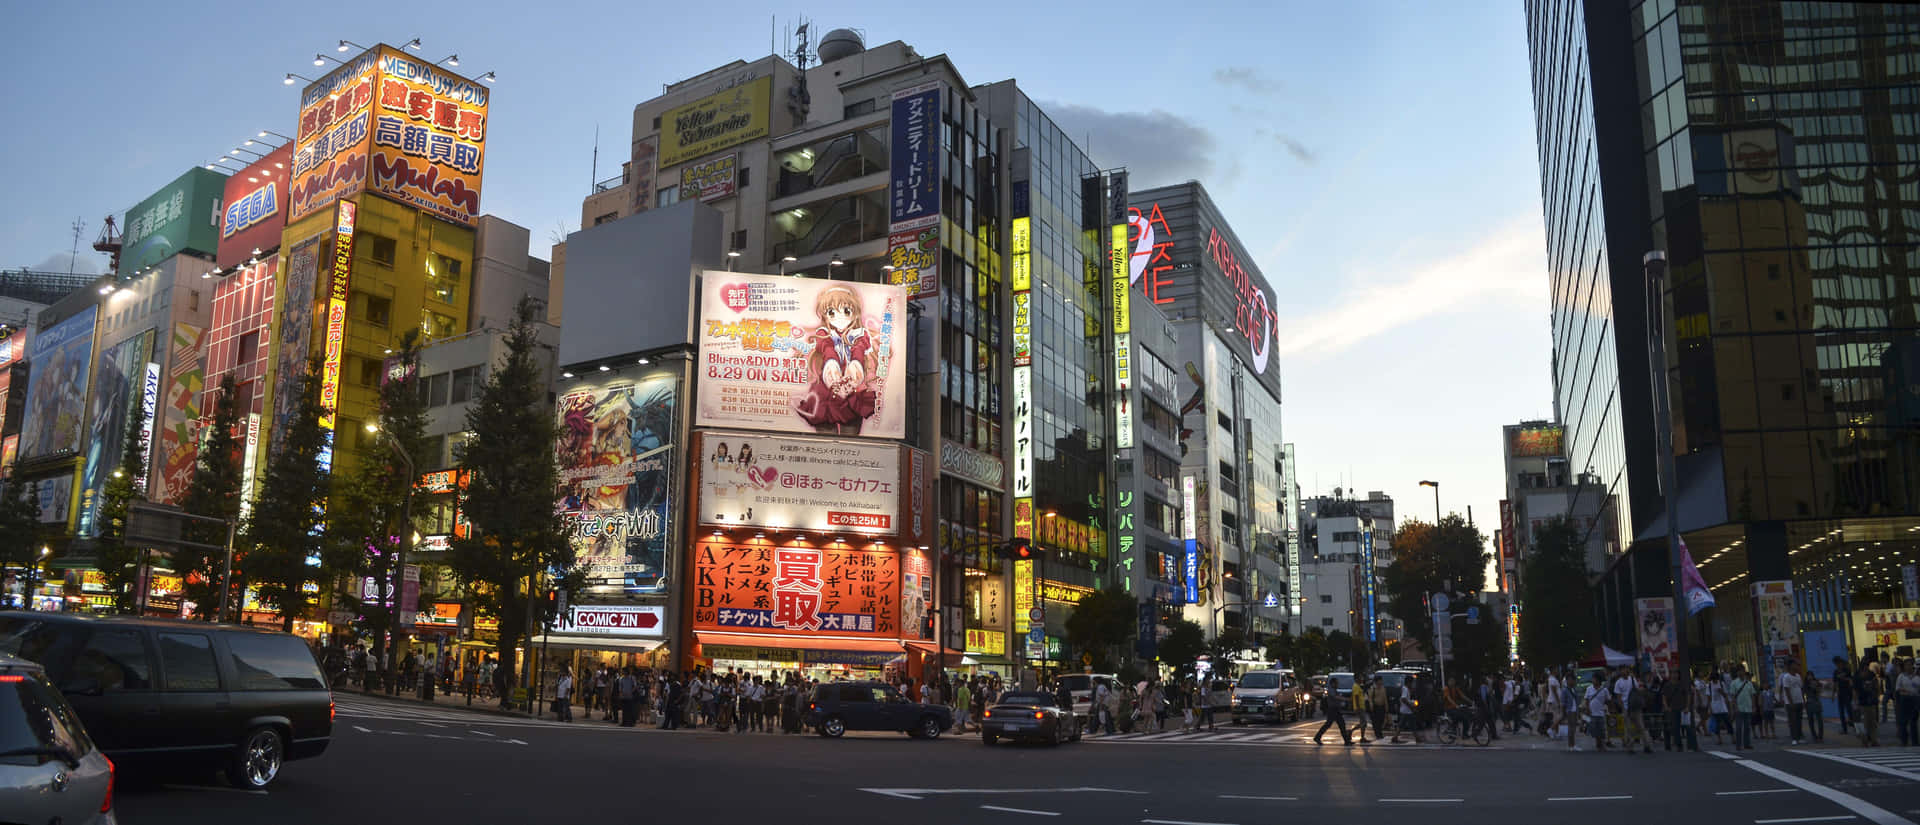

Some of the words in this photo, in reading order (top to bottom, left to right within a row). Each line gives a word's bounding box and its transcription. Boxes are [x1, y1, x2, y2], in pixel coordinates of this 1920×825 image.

[303, 51, 376, 111] MEDIAリサイクル
[384, 56, 486, 106] MEDIAリサイクル
[301, 75, 374, 142] 激安販売
[381, 78, 484, 140] 激安販売
[676, 109, 717, 134] Yellow
[295, 112, 369, 178] 高額買取
[375, 115, 480, 173] 高額買取
[907, 97, 923, 214] アメニティードリーム
[293, 153, 366, 216] Mulan
[372, 153, 479, 216] Mulan
[382, 185, 414, 203] ムーラン
[224, 181, 279, 241] SEGA
[891, 246, 936, 269] まんが
[891, 268, 919, 285] 喫茶
[1114, 247, 1123, 275] Yellow
[728, 288, 745, 299] 先行
[708, 353, 779, 367] Blu-ray&DVD
[708, 366, 742, 379] 8.29
[747, 368, 767, 381] ON
[771, 369, 806, 384] SALE
[1016, 401, 1030, 491] ルノアール
[624, 507, 659, 539] Will
[809, 499, 839, 507] Welcome
[831, 514, 878, 525] この先25M
[1119, 491, 1134, 592] リバティー
[719, 546, 736, 605] アイドル
[737, 548, 753, 591] アニメ
[753, 548, 771, 609] 美少女系
[773, 547, 823, 631] 買取
[825, 553, 841, 611] フィギュア
[844, 554, 858, 596] ホビー
[860, 553, 877, 614] 携帯電話
[878, 554, 894, 633] アップルとか
[1024, 578, 1032, 610] FREE
[578, 612, 618, 626] COMIC
[619, 614, 638, 627] ZIN
[718, 609, 769, 627] チケット
[825, 614, 873, 631] 大黒屋
